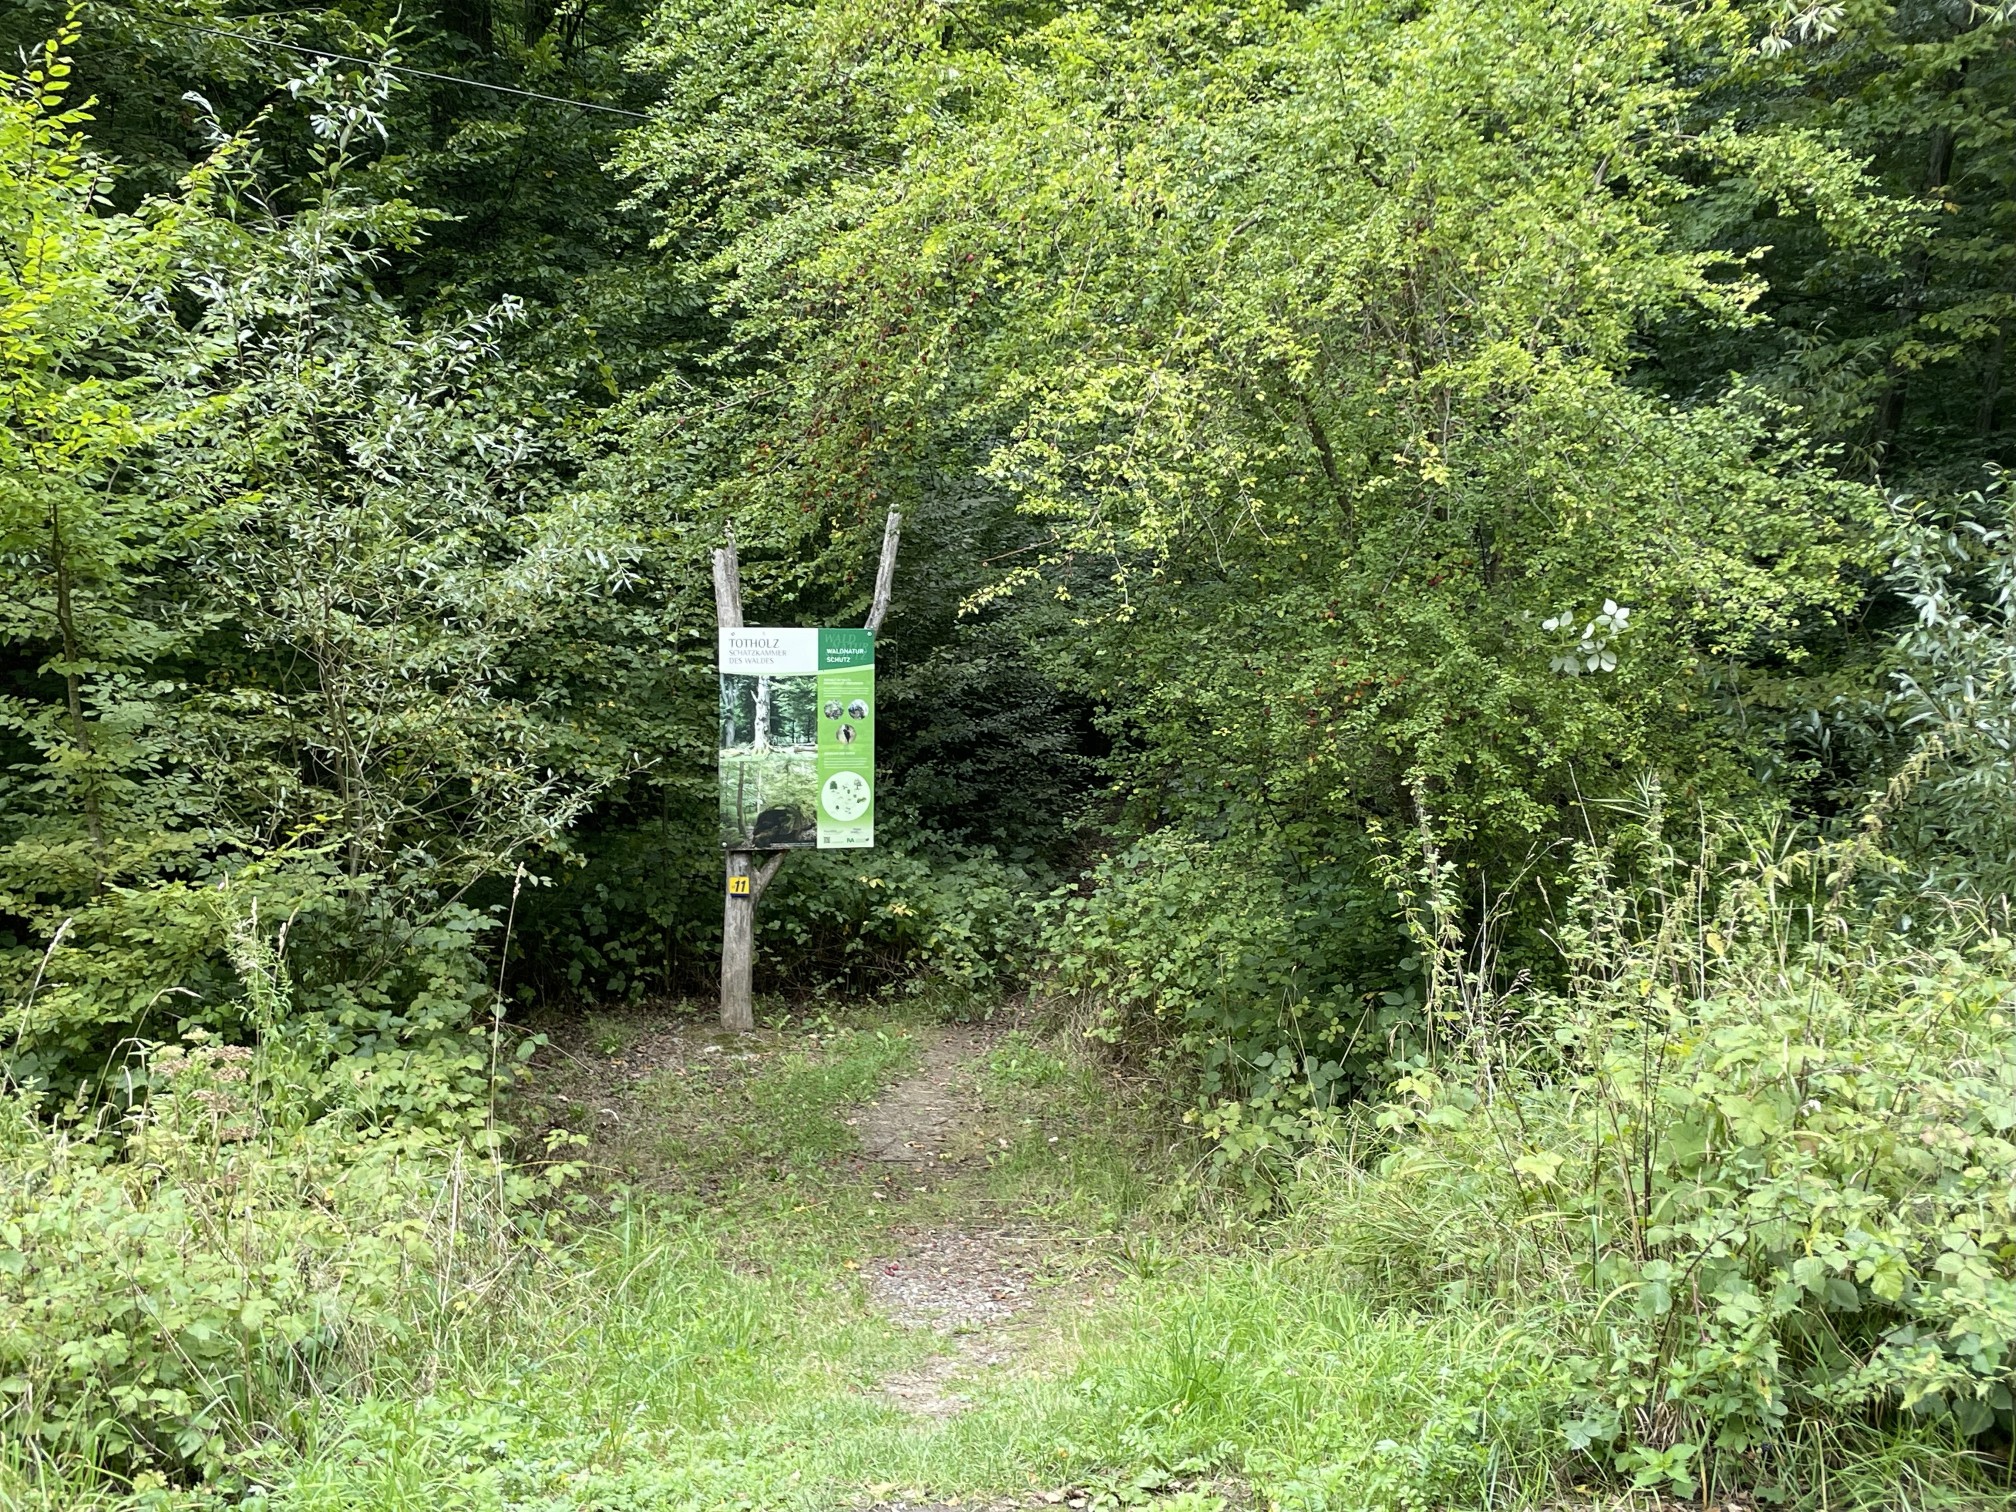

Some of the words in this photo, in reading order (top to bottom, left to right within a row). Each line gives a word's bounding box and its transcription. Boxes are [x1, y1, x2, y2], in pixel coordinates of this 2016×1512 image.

[825, 634, 856, 643] WALD
[729, 639, 780, 648] TOTHOLZ
[735, 880, 746, 893] 11
